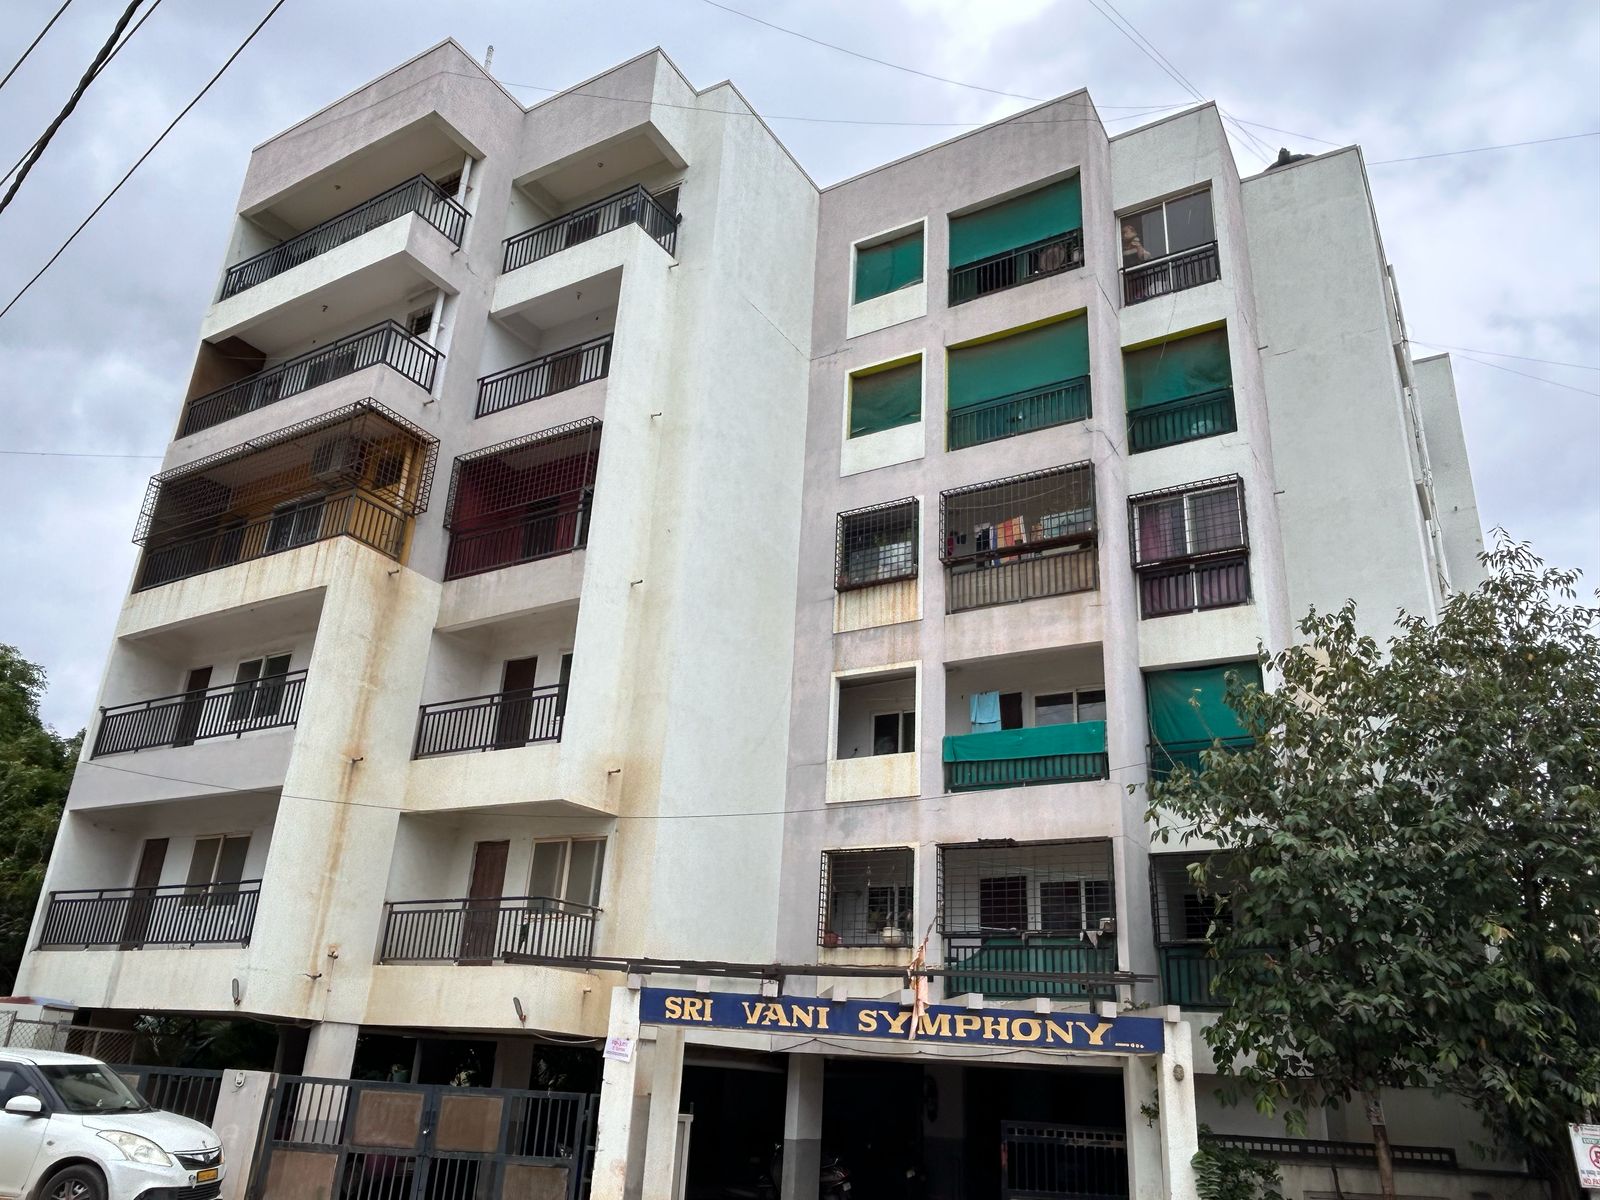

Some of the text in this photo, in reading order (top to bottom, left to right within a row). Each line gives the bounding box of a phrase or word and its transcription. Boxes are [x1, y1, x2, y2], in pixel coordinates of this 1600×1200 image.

[665, 996, 1113, 1046] SRI VANI SYMPHONY
